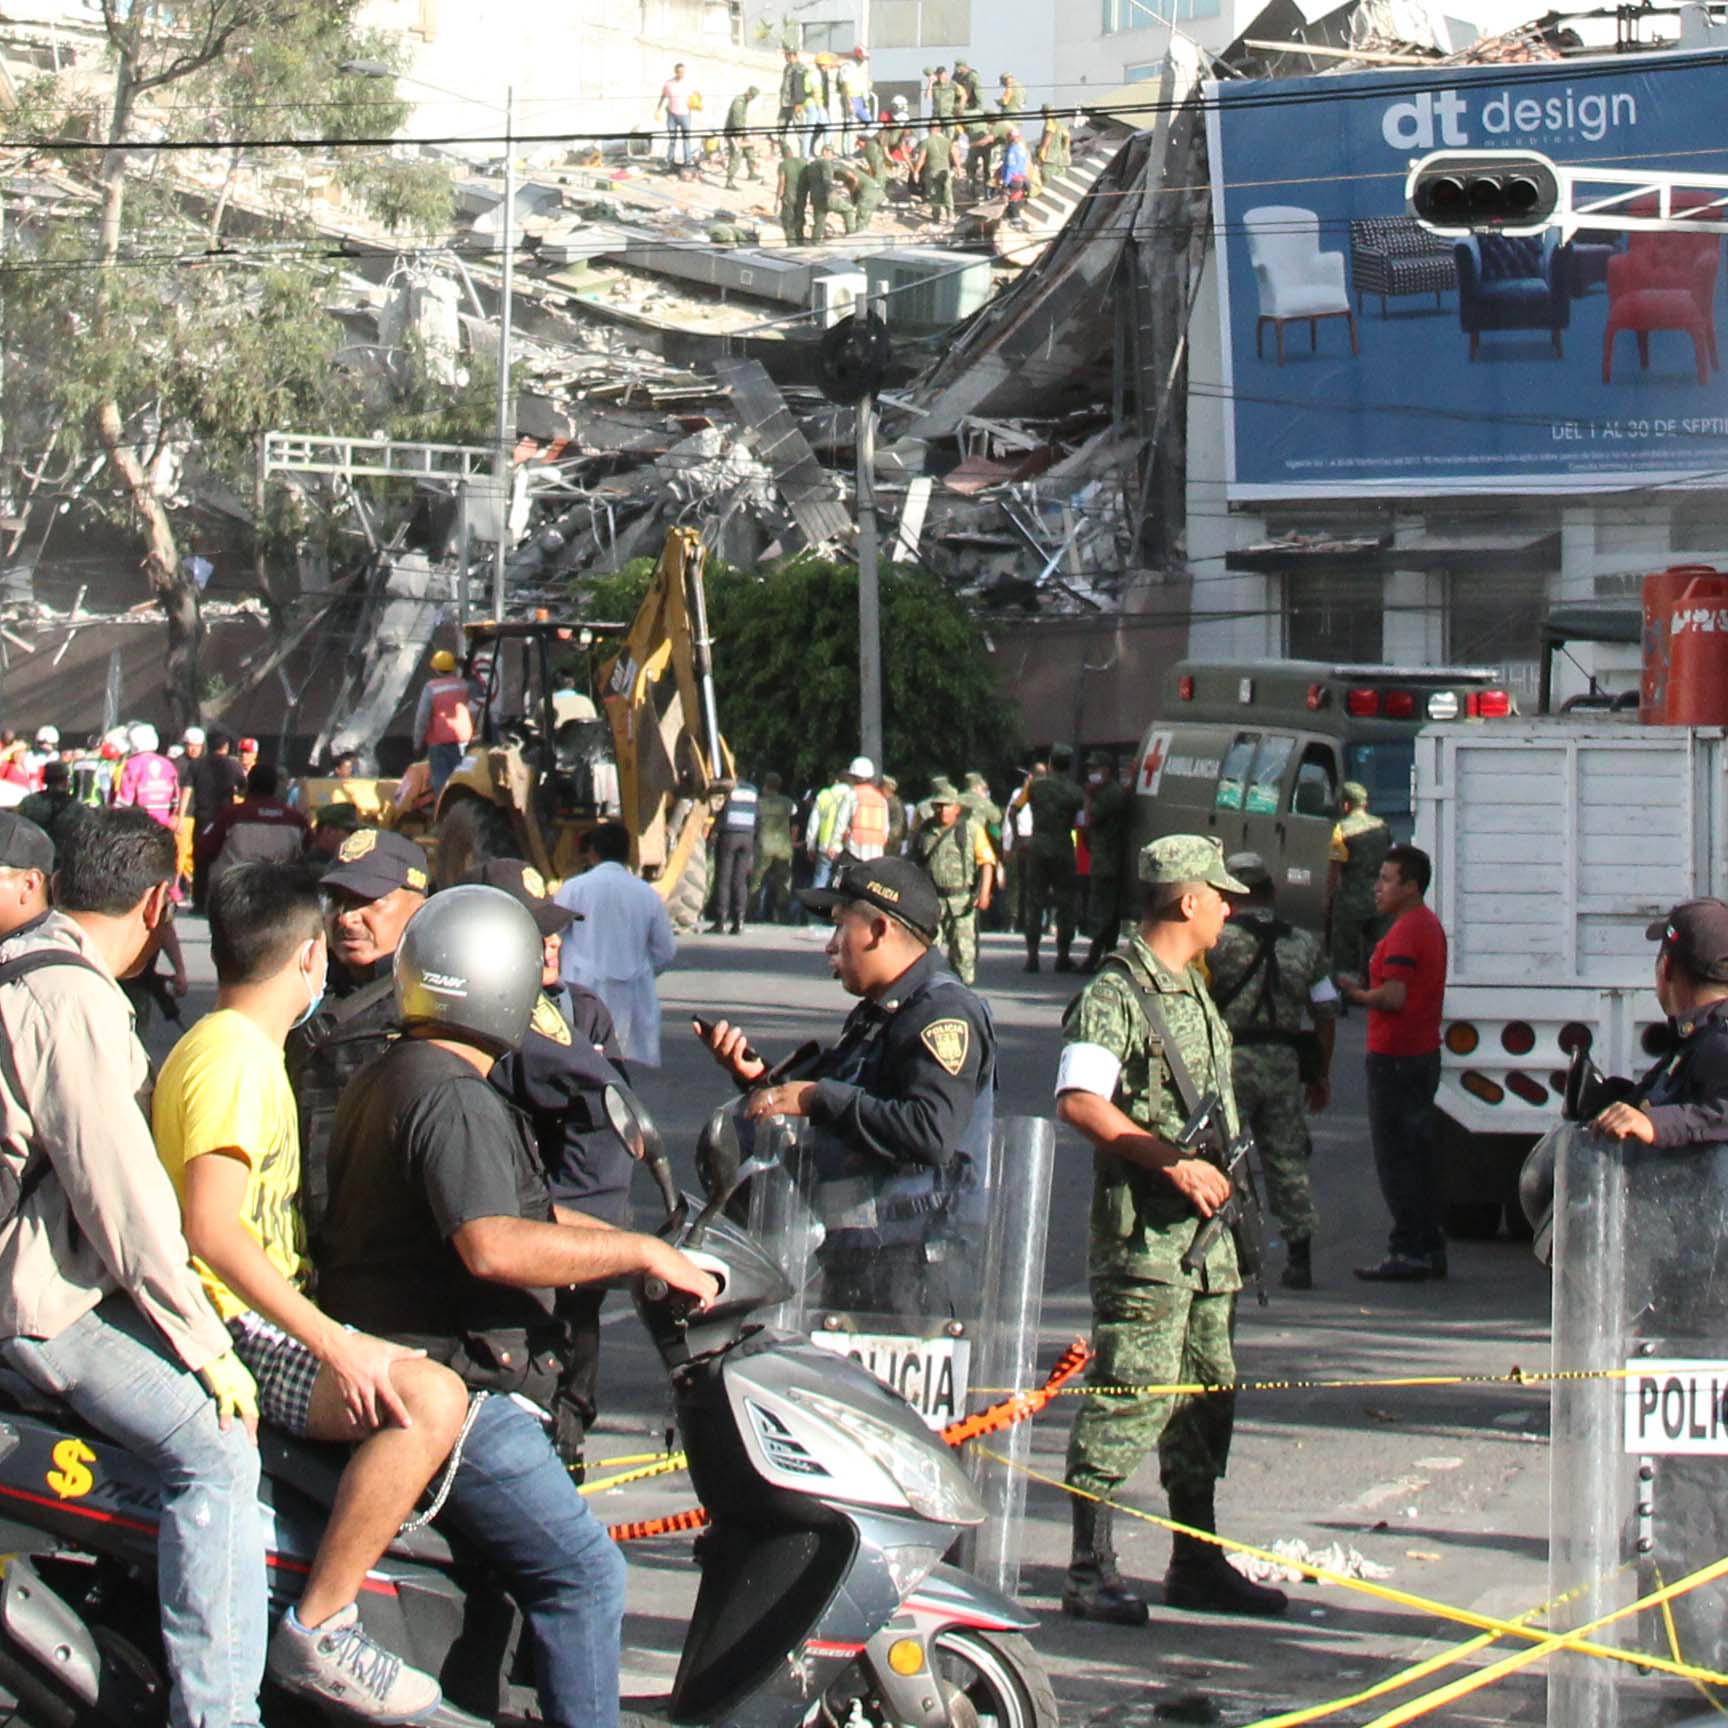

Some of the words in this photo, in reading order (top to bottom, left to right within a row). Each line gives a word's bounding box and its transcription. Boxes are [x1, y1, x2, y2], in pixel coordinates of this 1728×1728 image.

[1481, 88, 1638, 142] design
[1552, 423, 1582, 441] DEL
[1589, 423, 1596, 440] 1
[1602, 422, 1623, 440] AL
[1628, 421, 1649, 439] 30
[1654, 420, 1677, 438] DE
[1165, 754, 1220, 779] AMBULANCIA
[866, 880, 901, 904] POLICIA
[925, 1022, 964, 1039] POLICIA
